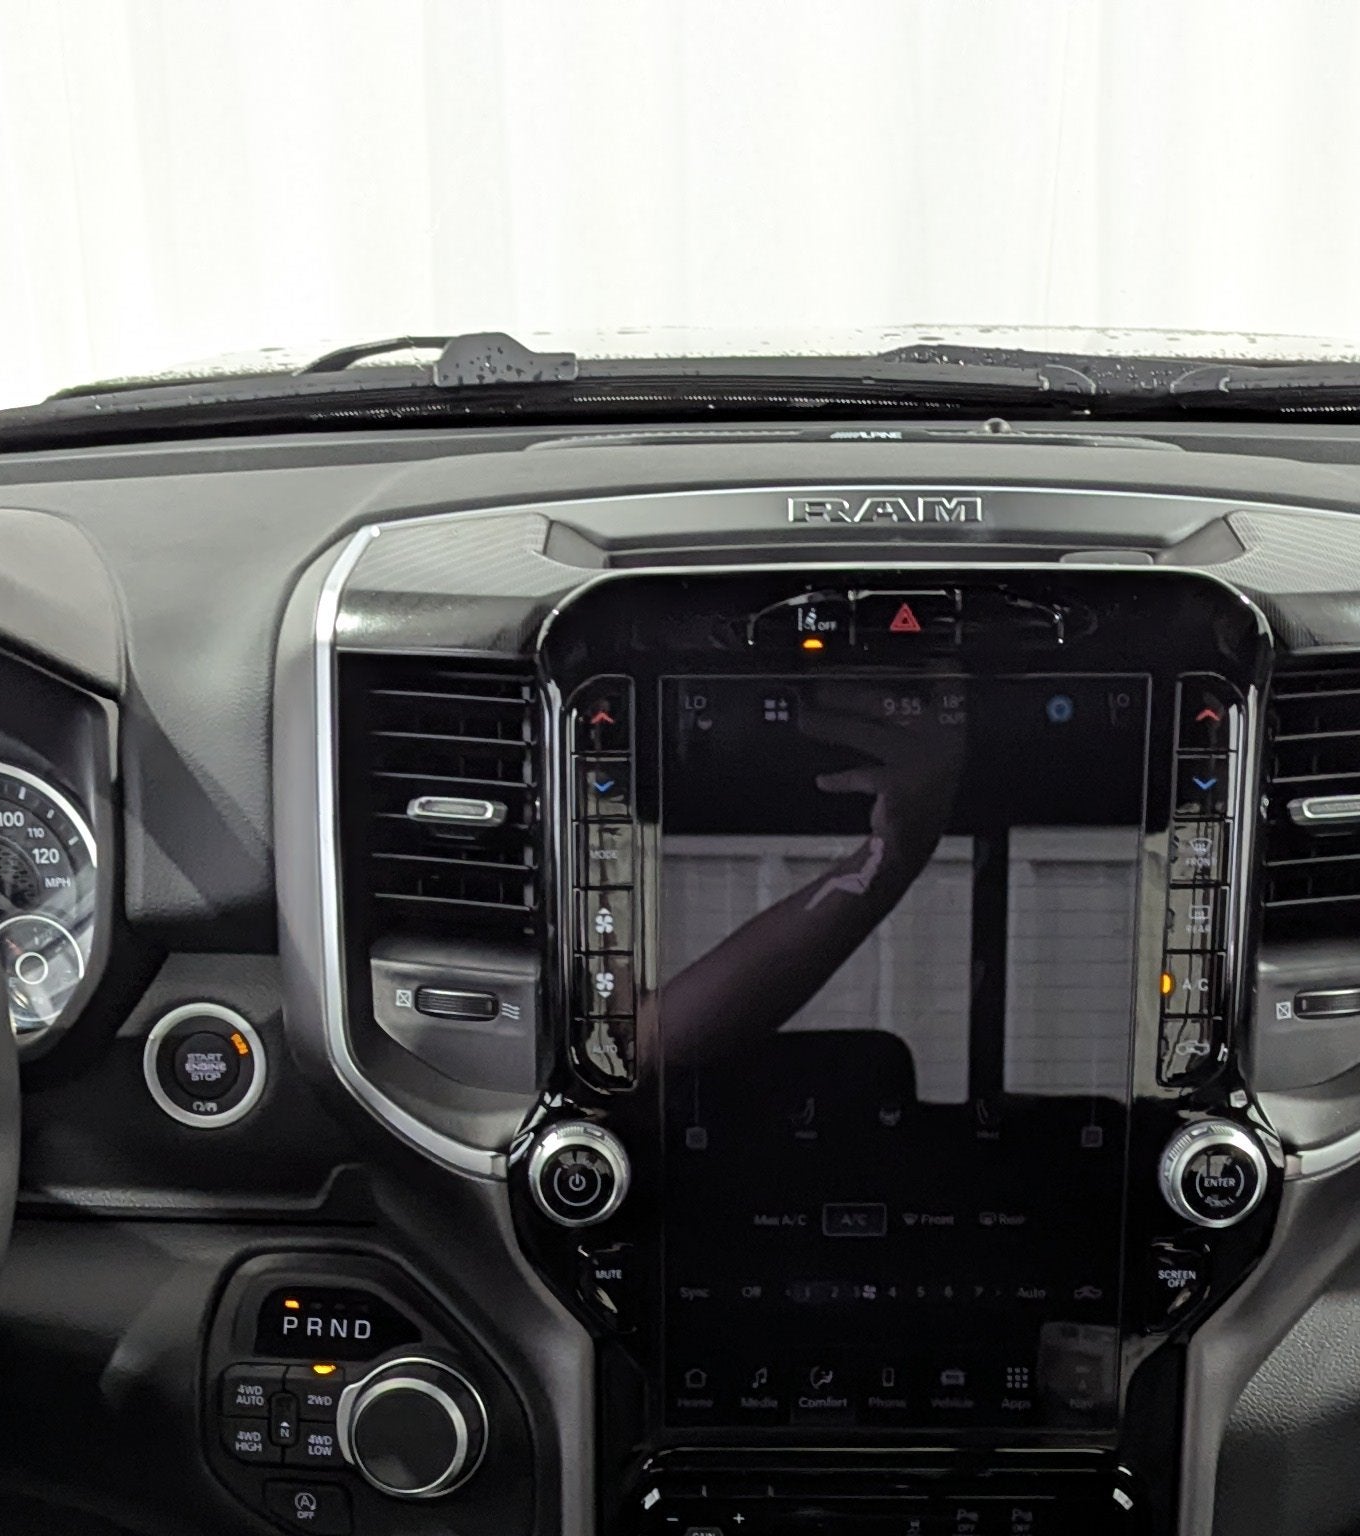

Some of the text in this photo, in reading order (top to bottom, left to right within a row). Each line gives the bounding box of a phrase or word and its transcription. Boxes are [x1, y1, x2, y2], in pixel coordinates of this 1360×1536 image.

[787, 497, 982, 522] RAM
[818, 621, 837, 631] OFF
[27, 827, 45, 839] 110
[32, 848, 60, 865] 120
[44, 877, 71, 888] MPH
[187, 1053, 223, 1061] START
[185, 1062, 227, 1072] ENGINE
[191, 1072, 221, 1081] STOP
[1204, 1178, 1236, 1187] ENTER
[595, 1269, 623, 1279] MUTE
[1158, 1270, 1197, 1280] SCREEN
[1167, 1279, 1187, 1288] OFF
[917, 1285, 925, 1298] 5
[1016, 1286, 1047, 1299] Auto
[237, 1384, 263, 1395] 4WD
[235, 1395, 265, 1406] AUTO
[307, 1394, 332, 1406] 2WD
[798, 1397, 848, 1408] Comfort
[1001, 1397, 1032, 1410] Apps
[237, 1431, 262, 1442] 4WD
[280, 1427, 290, 1438] N
[307, 1434, 333, 1445] 4WD
[235, 1441, 262, 1452] HIGH
[307, 1445, 333, 1456] LOW
[296, 1511, 315, 1519] OFF
